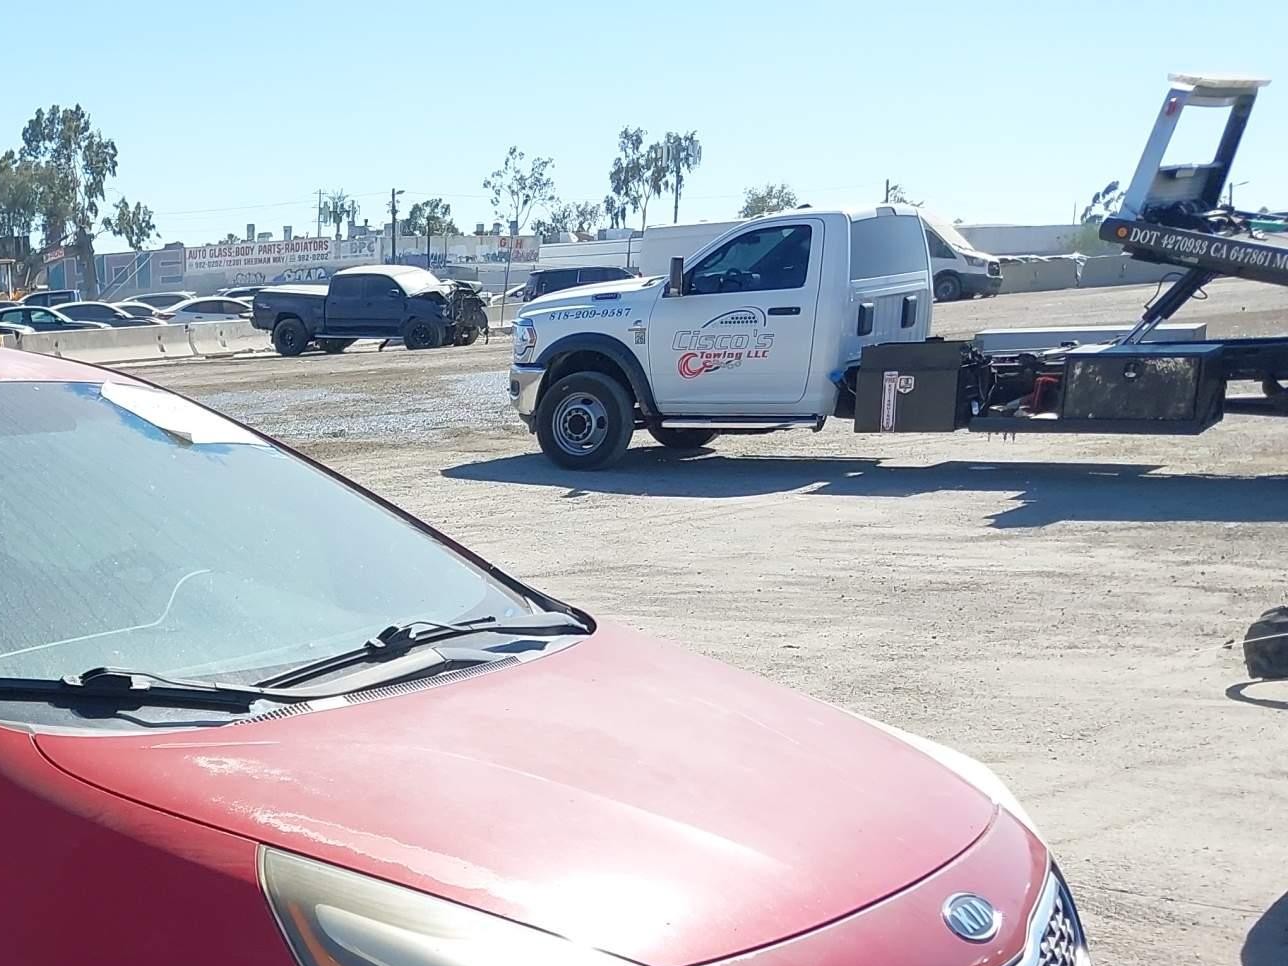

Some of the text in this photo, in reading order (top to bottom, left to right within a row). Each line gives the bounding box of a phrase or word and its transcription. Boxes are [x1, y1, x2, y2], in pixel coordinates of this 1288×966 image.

[188, 248, 207, 260] AUTO
[1130, 227, 1288, 270] DOT 4270933 CA 647861 M
[549, 307, 632, 321] 818-209-9587
[671, 329, 775, 351] Cisco's
[746, 350, 770, 359] LLC
